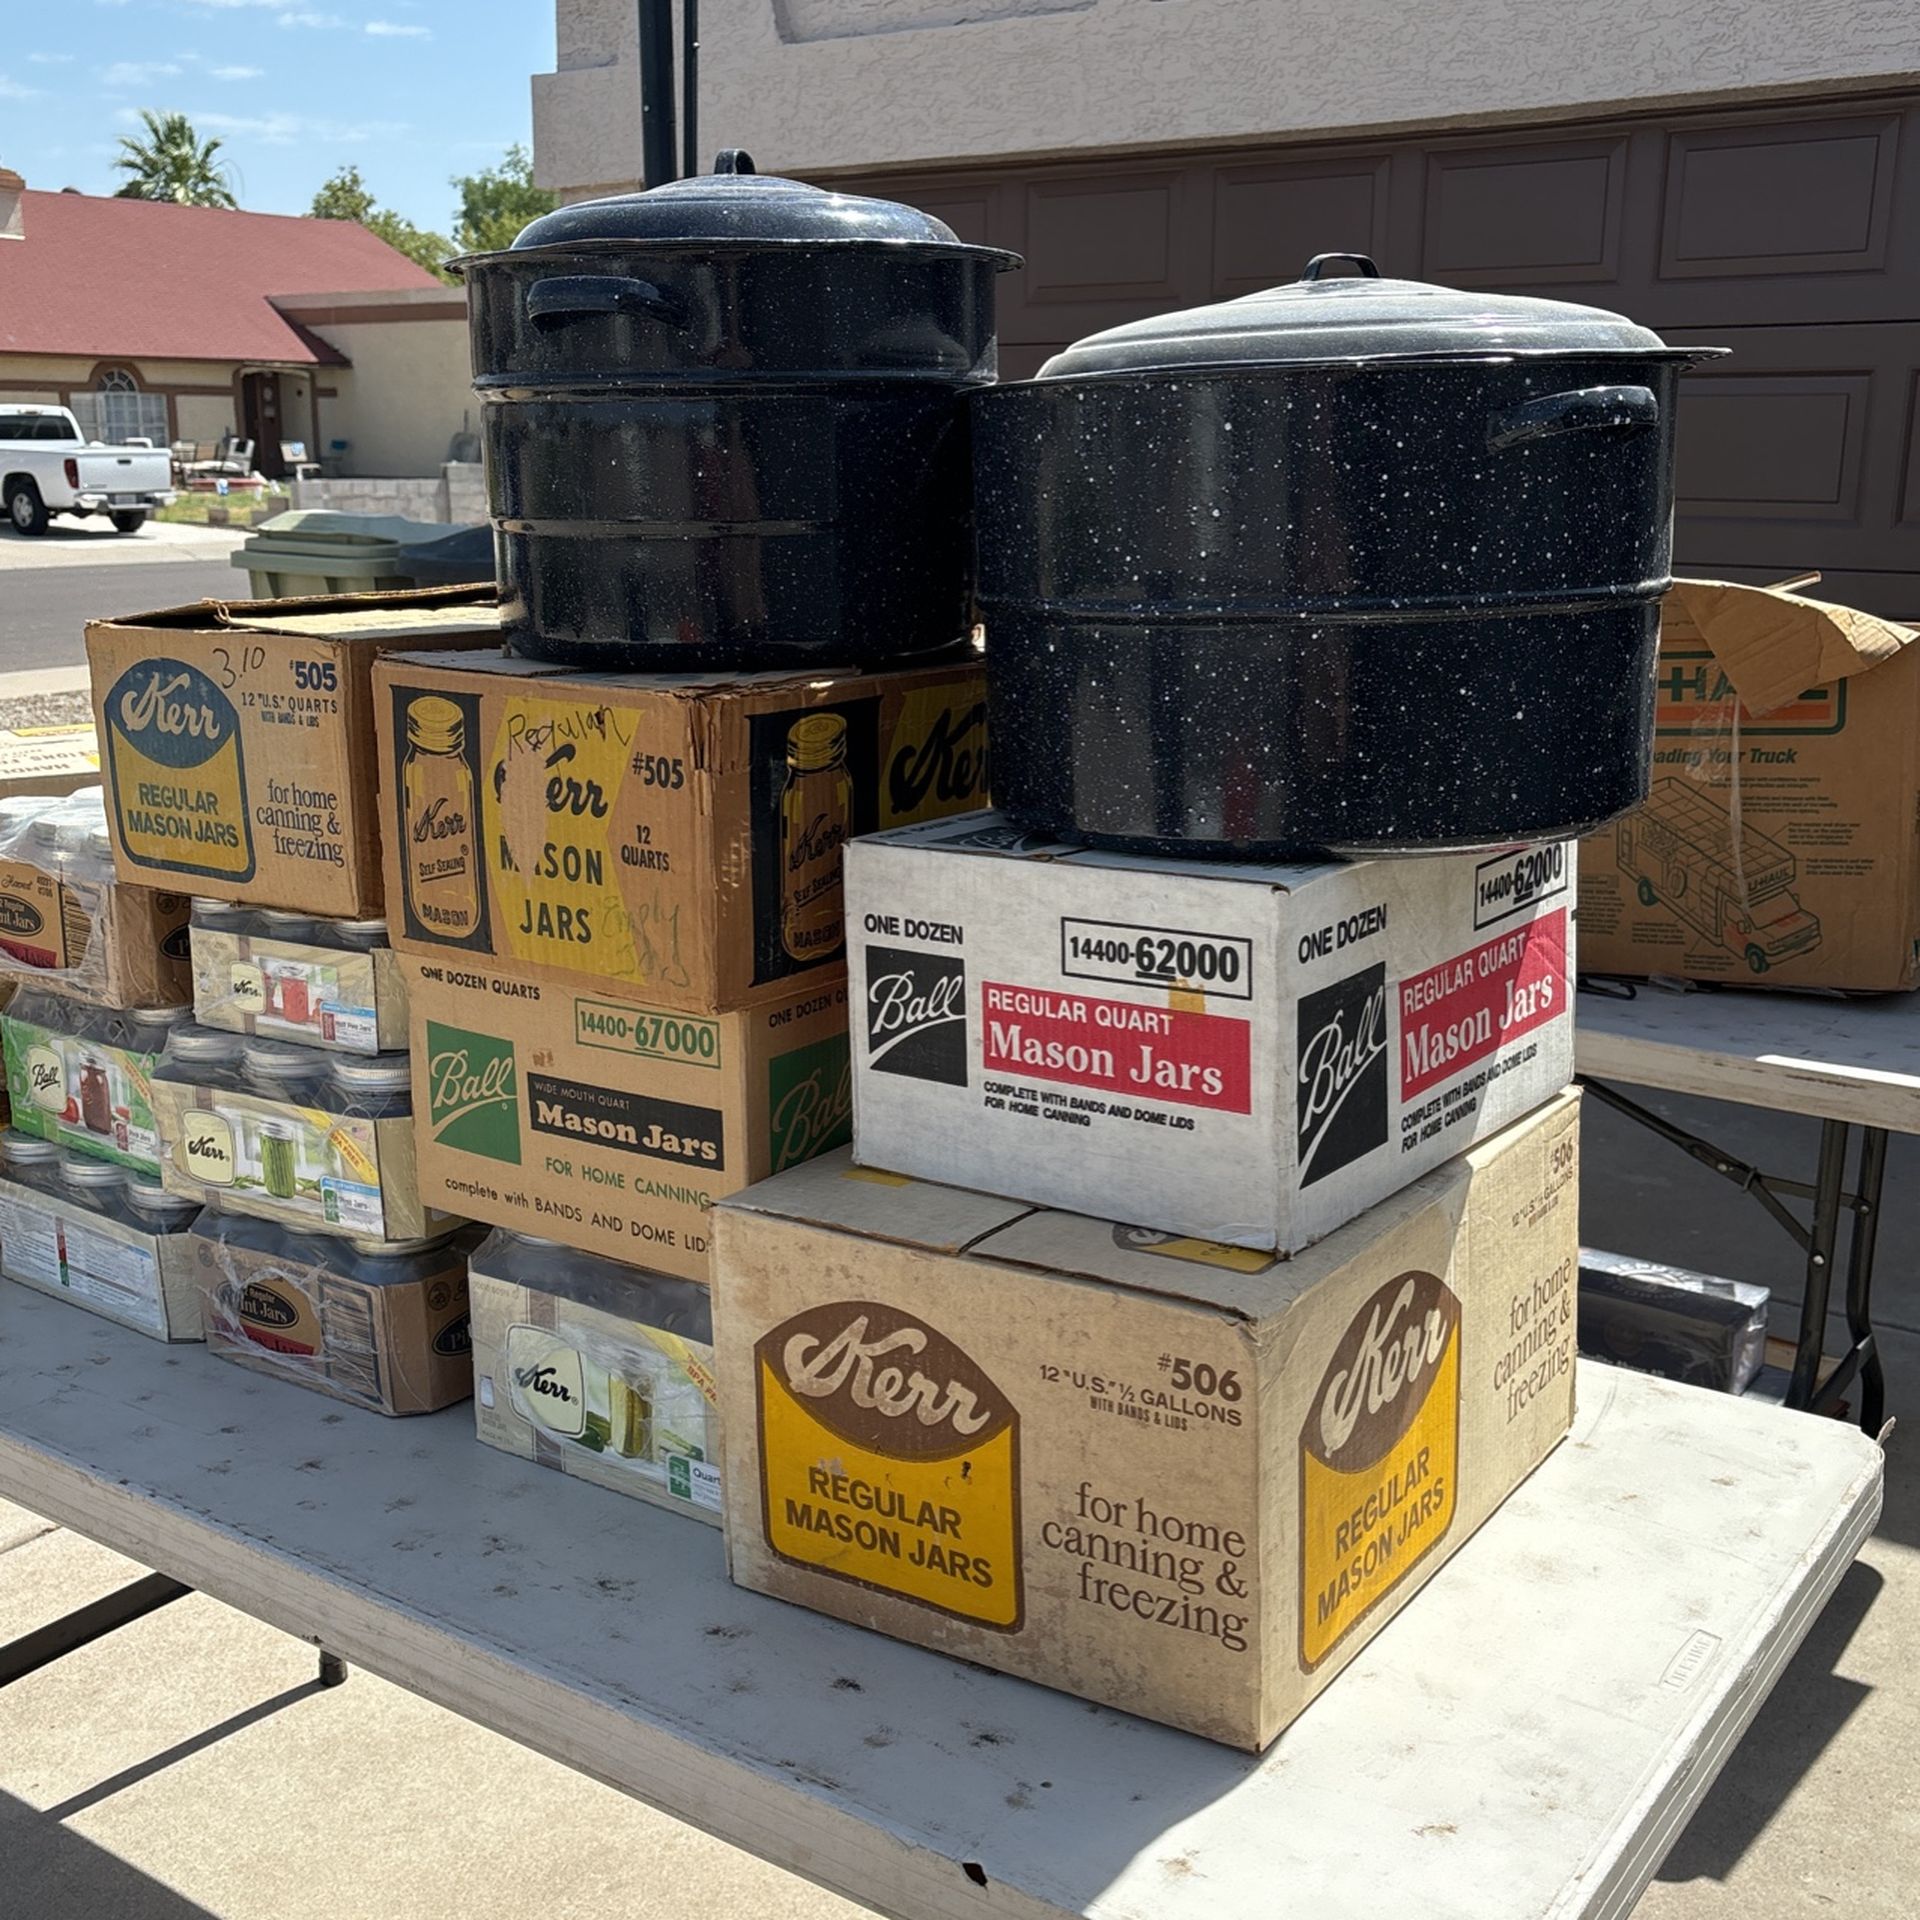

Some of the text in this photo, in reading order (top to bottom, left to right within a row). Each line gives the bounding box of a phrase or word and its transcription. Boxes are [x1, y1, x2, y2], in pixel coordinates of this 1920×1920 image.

[213, 646, 265, 689] 3.10
[121, 671, 220, 740] Kerr
[241, 692, 255, 707] 12
[288, 695, 338, 714] QUARTS
[494, 743, 608, 819] err
[632, 751, 685, 790] #505
[1653, 748, 1701, 768] ading
[1750, 748, 1798, 764] Truck
[138, 782, 219, 815] REGULAR
[267, 778, 338, 811] for home
[127, 810, 239, 848] MASON JARS
[256, 806, 342, 838] canning &
[413, 797, 467, 843] Kerr
[636, 824, 651, 845] 12
[273, 828, 345, 868] freezing
[499, 835, 604, 886] MSON
[621, 844, 670, 872] QUARTS
[1479, 843, 1562, 907] 14400-62000
[519, 898, 592, 944] JARS
[864, 913, 964, 945] ONE DOZEN
[1299, 903, 1387, 964] ONE DOZEN
[420, 965, 541, 1000] ONE DOZEN QUARTS
[1069, 935, 1240, 983] 14400-62000
[1403, 931, 1527, 1017] REGULAR QUART
[769, 1007, 792, 1028] ONE
[796, 993, 832, 1019] DOZEN
[869, 969, 966, 1035] Ball
[988, 989, 1173, 1036] REGULAR QUART
[580, 1010, 715, 1058] 14400-67000
[1405, 973, 1554, 1083] Mason Jars
[32, 1063, 60, 1091] Ball
[430, 1049, 518, 1109] Ball
[988, 1020, 1224, 1097] Mason Jars
[1300, 985, 1388, 1135] Ball
[534, 1081, 631, 1111] WIDE MOUTH QUART
[772, 1062, 852, 1174] Bal
[984, 1081, 1195, 1131] COMPLETE WITH BANDS AND DOME LIDS
[984, 1096, 1091, 1127] FOR HOME CANNING
[1401, 1096, 1442, 1133] COMPLETE
[188, 1135, 225, 1161] Kerr
[536, 1100, 718, 1161] Mason Jars
[1401, 1131, 1418, 1154] FOR
[546, 1156, 711, 1209] FOR HOME CANNING
[445, 1176, 711, 1254] complete with BANDS AND DOME LID
[259, 1303, 288, 1323] Jars
[1510, 1257, 1571, 1338] for home
[1494, 1289, 1571, 1391] canning &
[514, 1363, 571, 1402] Kerr
[783, 1315, 991, 1436] Kerr
[1156, 1352, 1243, 1402] #506
[1318, 1279, 1447, 1459] Kerr
[1507, 1335, 1570, 1425] freezing
[1040, 1364, 1060, 1383] 12
[1140, 1388, 1243, 1427] GALLONS
[1089, 1395, 1189, 1432] WITH BANDS & LIDS
[808, 1465, 962, 1540] REGULAR
[1075, 1481, 1246, 1558] for home
[1334, 1446, 1431, 1562] REGULAR
[784, 1498, 994, 1590] MASON JARS
[1042, 1521, 1249, 1599] canning &
[1317, 1477, 1444, 1627] MASON JARS
[1076, 1563, 1249, 1652] freezing
